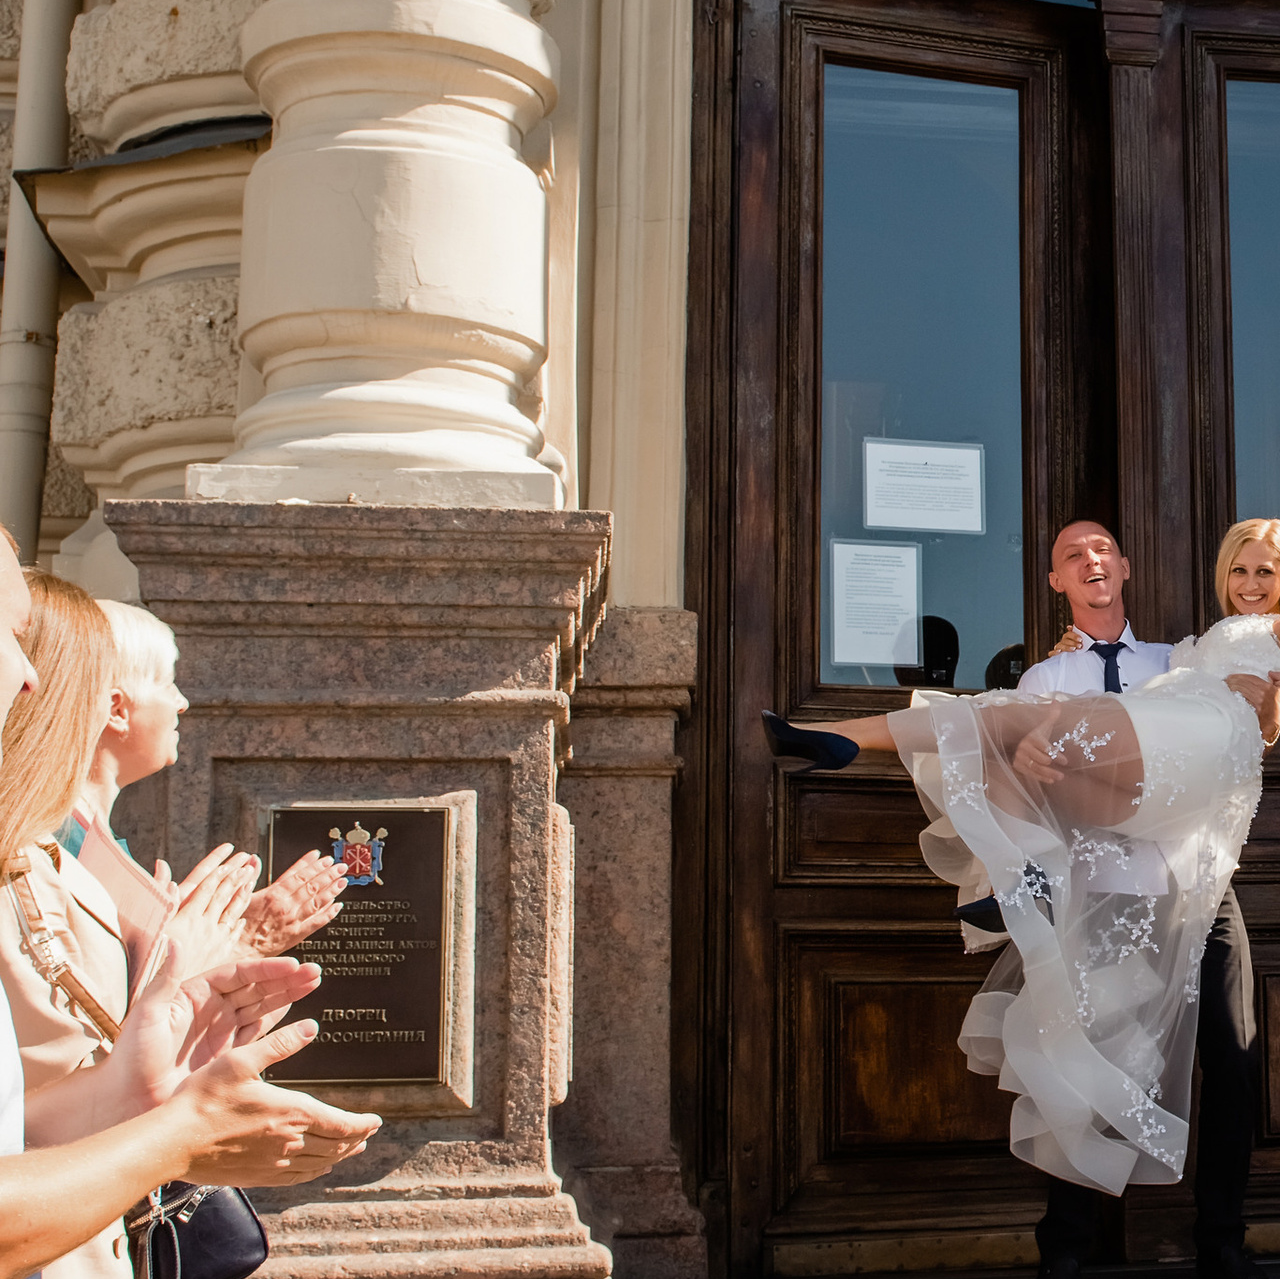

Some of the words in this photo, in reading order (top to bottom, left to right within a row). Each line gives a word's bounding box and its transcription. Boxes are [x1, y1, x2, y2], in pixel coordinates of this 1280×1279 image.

[342, 900, 411, 911] ТЕЛЬСТВО
[329, 913, 418, 923] -ПЕТЕРБУРГА
[327, 927, 385, 936] КОМИТЕТ
[345, 940, 394, 950] ЗАПИСИ
[398, 940, 438, 949] АКТОВ
[303, 953, 406, 964] ГРАЖДАНСКОГО
[321, 966, 391, 977] ОСТОЯНИЯ
[322, 1008, 387, 1022] ДВОРЕЦ
